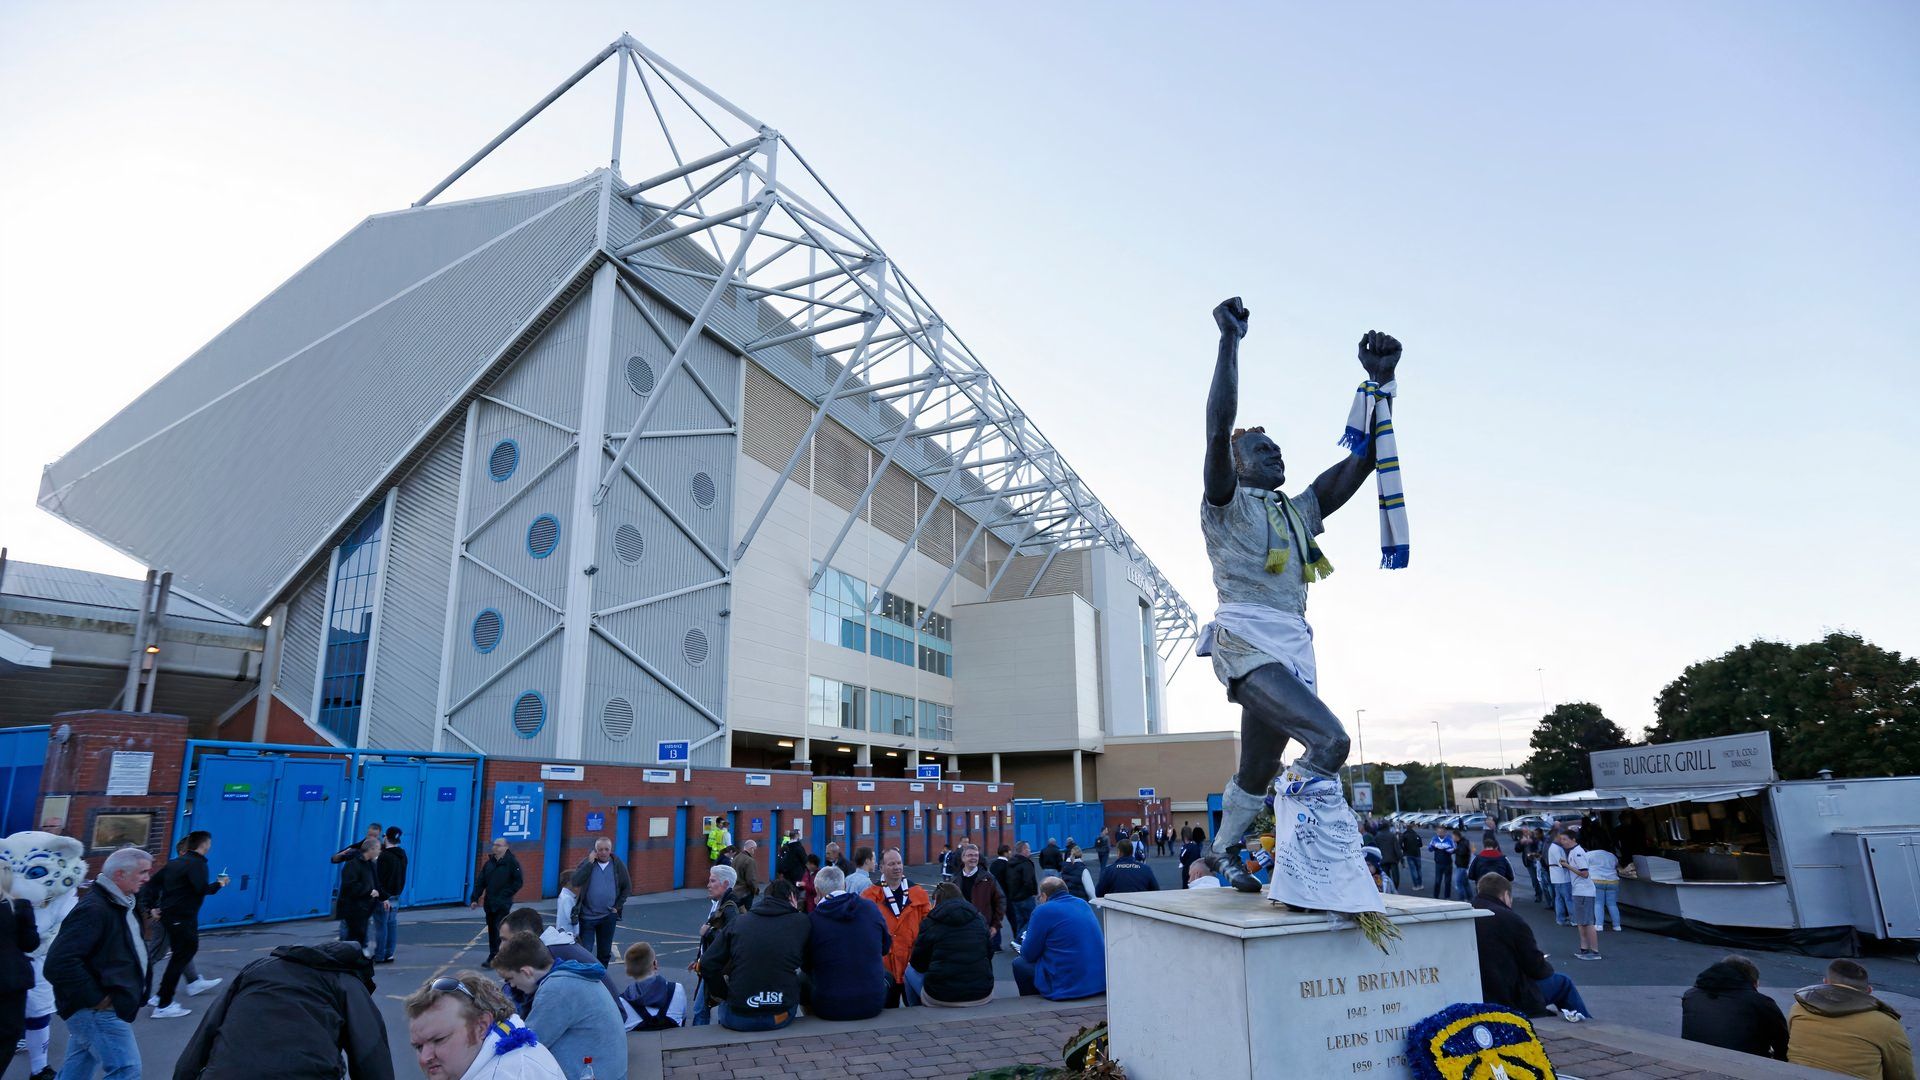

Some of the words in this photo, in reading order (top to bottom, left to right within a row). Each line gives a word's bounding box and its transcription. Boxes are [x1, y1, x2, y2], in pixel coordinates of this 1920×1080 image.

[669, 749, 677, 759] 13
[1623, 753, 1673, 776] BURGER
[1675, 749, 1716, 773] GRILL
[1299, 976, 1346, 999] BILLY
[1357, 966, 1440, 993] BREMNER
[1347, 1006, 1367, 1019] 1942
[1381, 1002, 1401, 1015] 1997
[1326, 1032, 1368, 1050] LEEDS
[1375, 1026, 1416, 1043] UNITE
